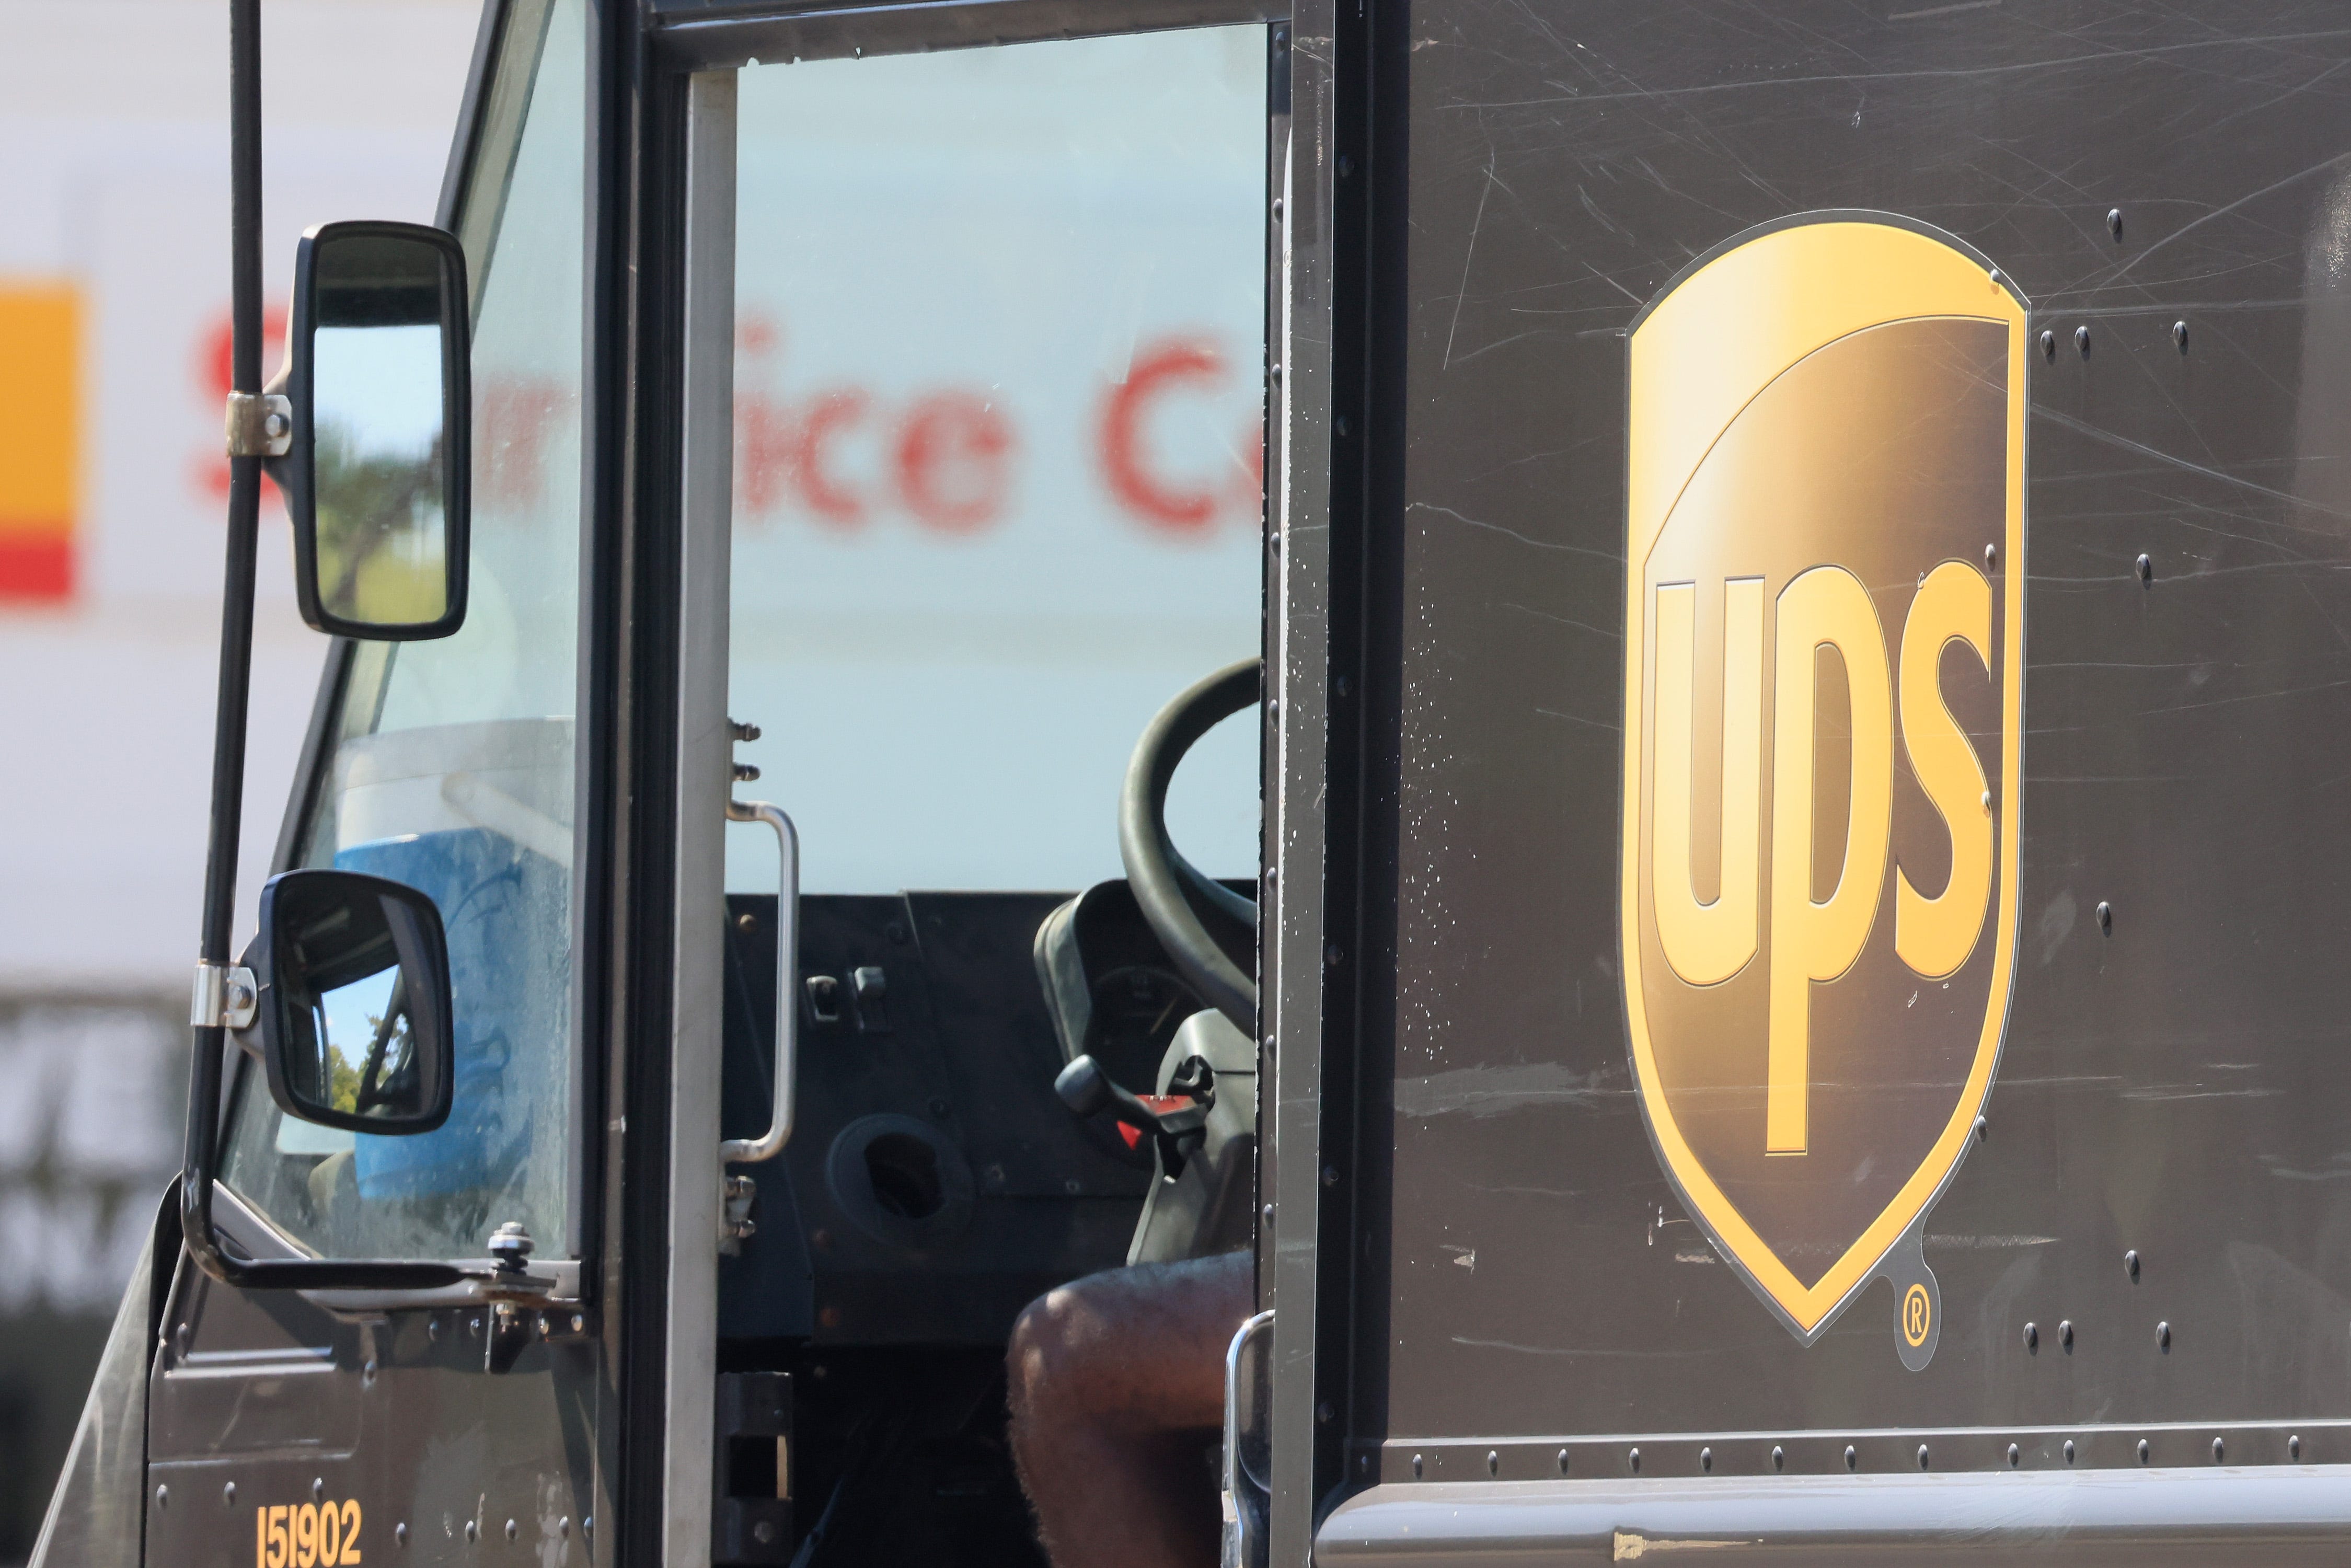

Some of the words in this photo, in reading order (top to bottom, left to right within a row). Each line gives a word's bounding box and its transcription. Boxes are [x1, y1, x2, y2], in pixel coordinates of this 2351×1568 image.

[1090, 335, 1264, 534] C
[1651, 559, 1993, 1155] ups
[257, 1498, 362, 1568] 151902
